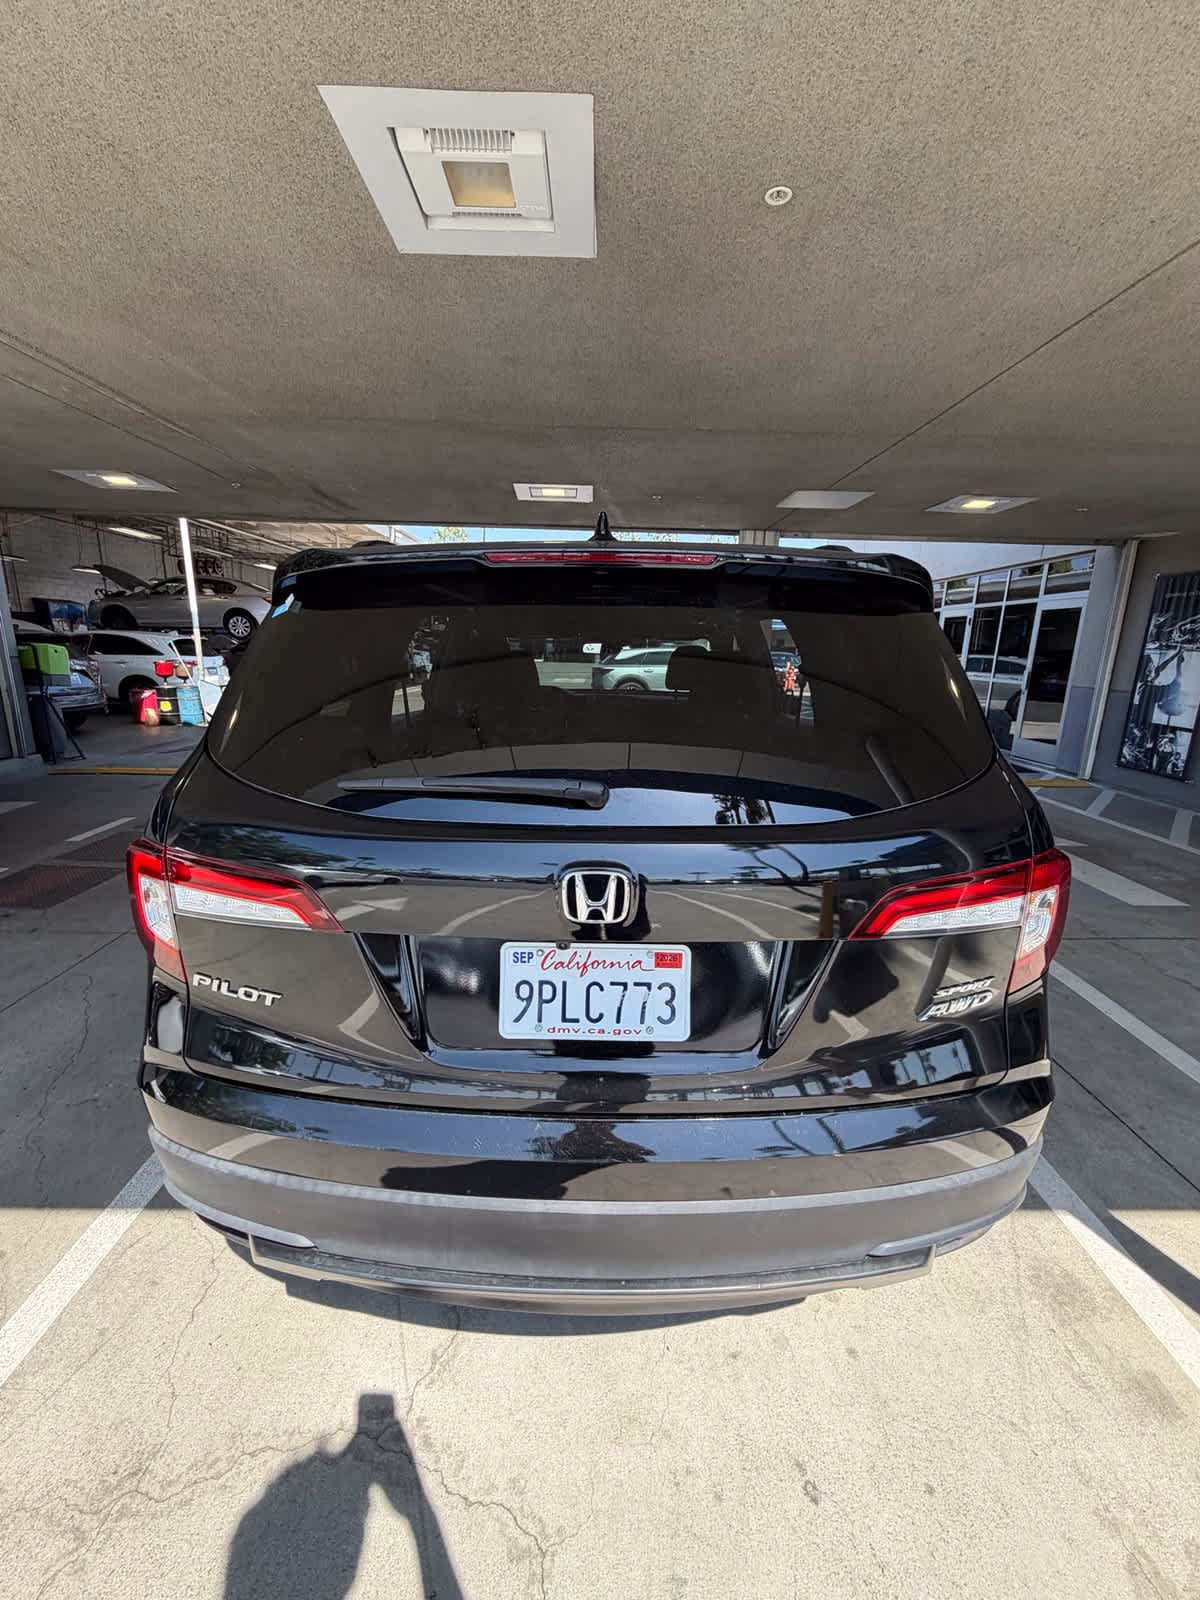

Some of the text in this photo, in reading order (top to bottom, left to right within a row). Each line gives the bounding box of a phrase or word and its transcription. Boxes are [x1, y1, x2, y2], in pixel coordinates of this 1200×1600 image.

[512, 951, 535, 964] SEP
[540, 949, 656, 977] California
[659, 954, 677, 962] 2026
[192, 973, 283, 1007] PILOT
[932, 976, 995, 999] SPORT
[512, 979, 677, 1025] 9PLC773
[918, 991, 993, 1022] AWD
[546, 1025, 642, 1036] dmv.ca.gov
